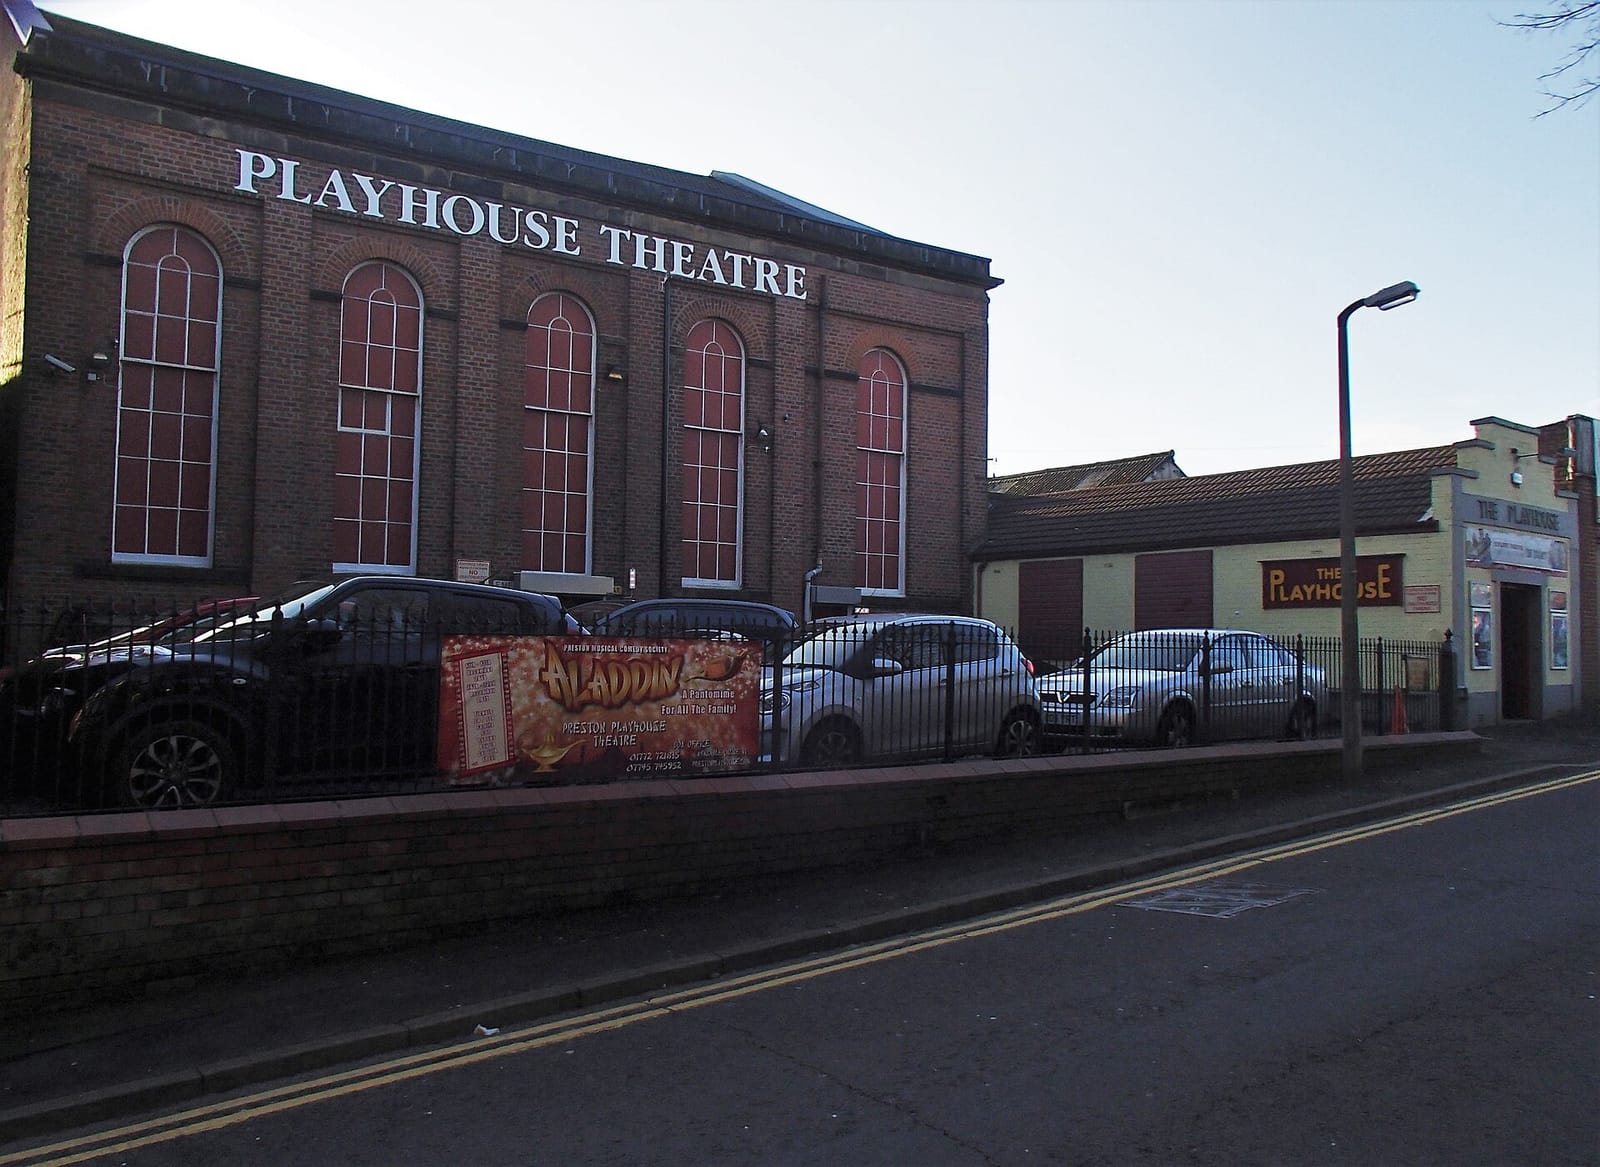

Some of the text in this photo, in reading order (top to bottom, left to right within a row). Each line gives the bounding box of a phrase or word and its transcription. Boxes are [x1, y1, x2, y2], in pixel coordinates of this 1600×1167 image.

[234, 149, 808, 300] PLAYHOUSE THEATRE
[1316, 568, 1342, 580] THE
[563, 644, 590, 653] PRESTON
[591, 644, 618, 653] MUSICAL
[619, 645, 643, 654] COMEDY
[541, 642, 683, 709] ALADDIN
[689, 689, 735, 699] Pantomime
[661, 704, 737, 716] For All The Family!
[562, 720, 667, 734] PRESTON PLAYHOUSE
[593, 734, 637, 747] THEATRE
